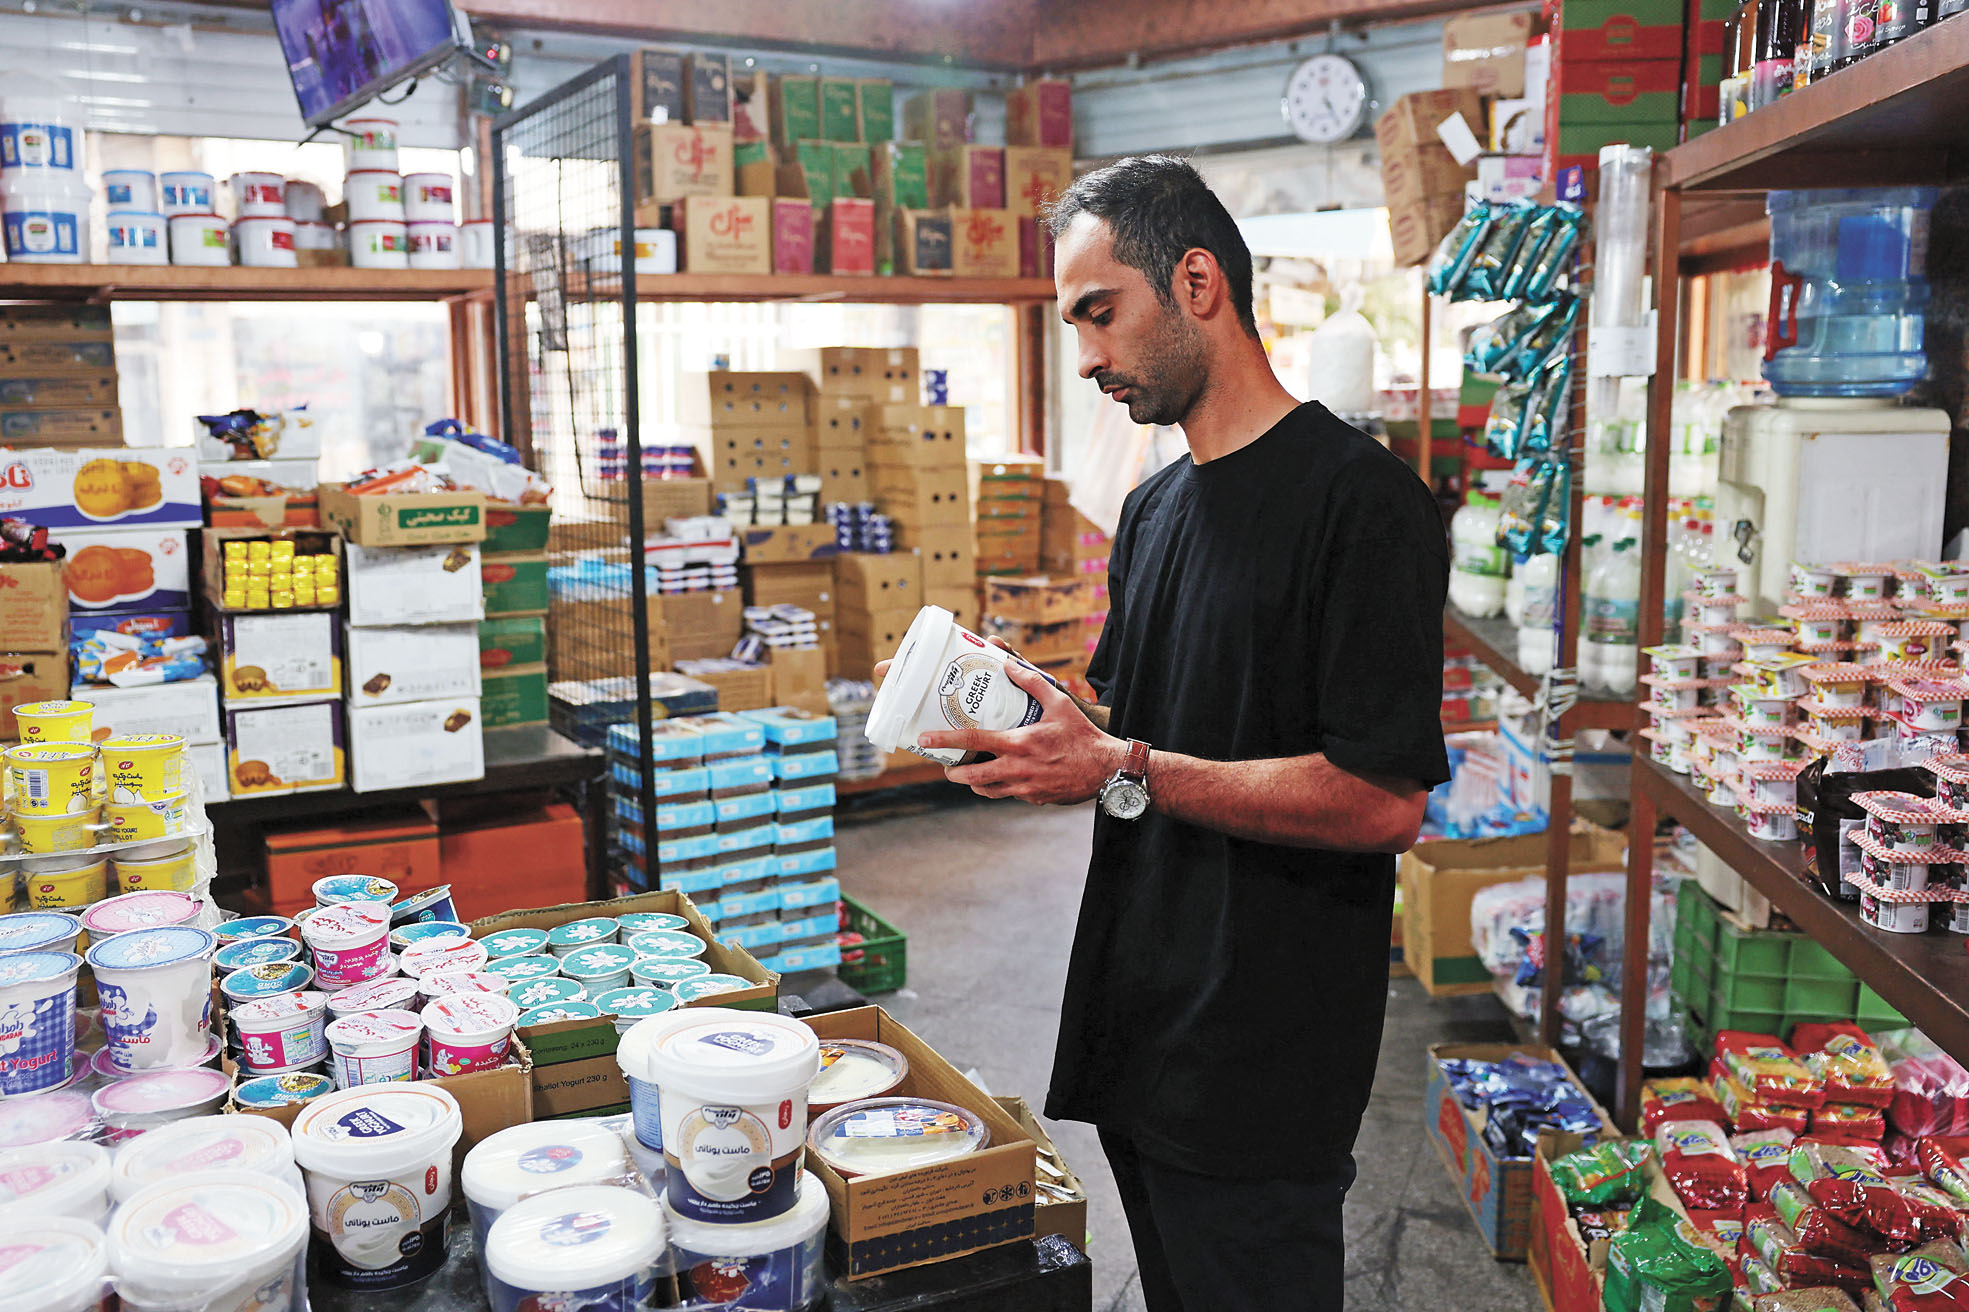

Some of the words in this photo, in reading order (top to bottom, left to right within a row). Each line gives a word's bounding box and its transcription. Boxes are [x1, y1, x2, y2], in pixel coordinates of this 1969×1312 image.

[966, 675, 983, 705] GREEK
[968, 672, 992, 715] YOGHURT
[113, 1032, 151, 1044] ماست
[570, 1042, 580, 1050] 24
[586, 1039, 600, 1047] 230
[11, 1050, 58, 1072] Yogurt
[533, 1080, 559, 1092] Shallot
[560, 1078, 585, 1090] Yogurt
[586, 1075, 601, 1084] 230
[348, 1117, 373, 1134] GREEK
[355, 1112, 388, 1135] YOGHURT
[695, 1146, 720, 1155] یونانی
[722, 1146, 750, 1155] ماست
[344, 1220, 370, 1228] یونانی
[372, 1216, 400, 1226] ماست
